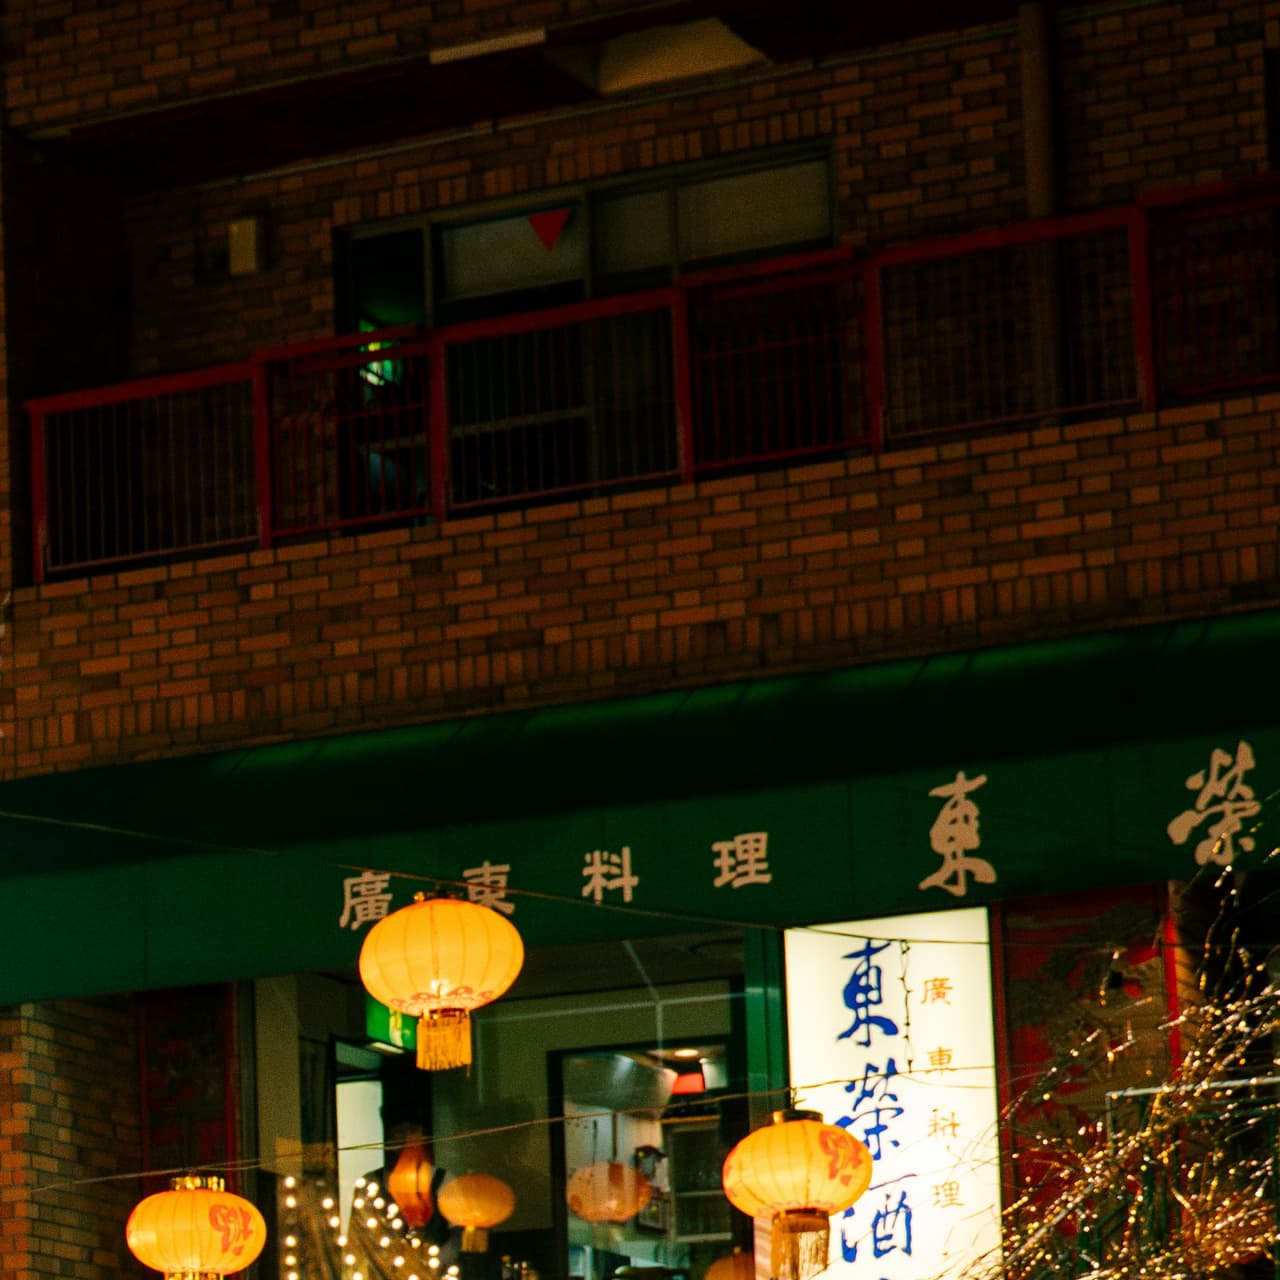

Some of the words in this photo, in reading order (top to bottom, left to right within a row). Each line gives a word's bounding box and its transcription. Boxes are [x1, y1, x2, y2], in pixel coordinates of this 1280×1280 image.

[338, 831, 771, 931] 廣東料理
[920, 975, 967, 1209] 廣東料理
